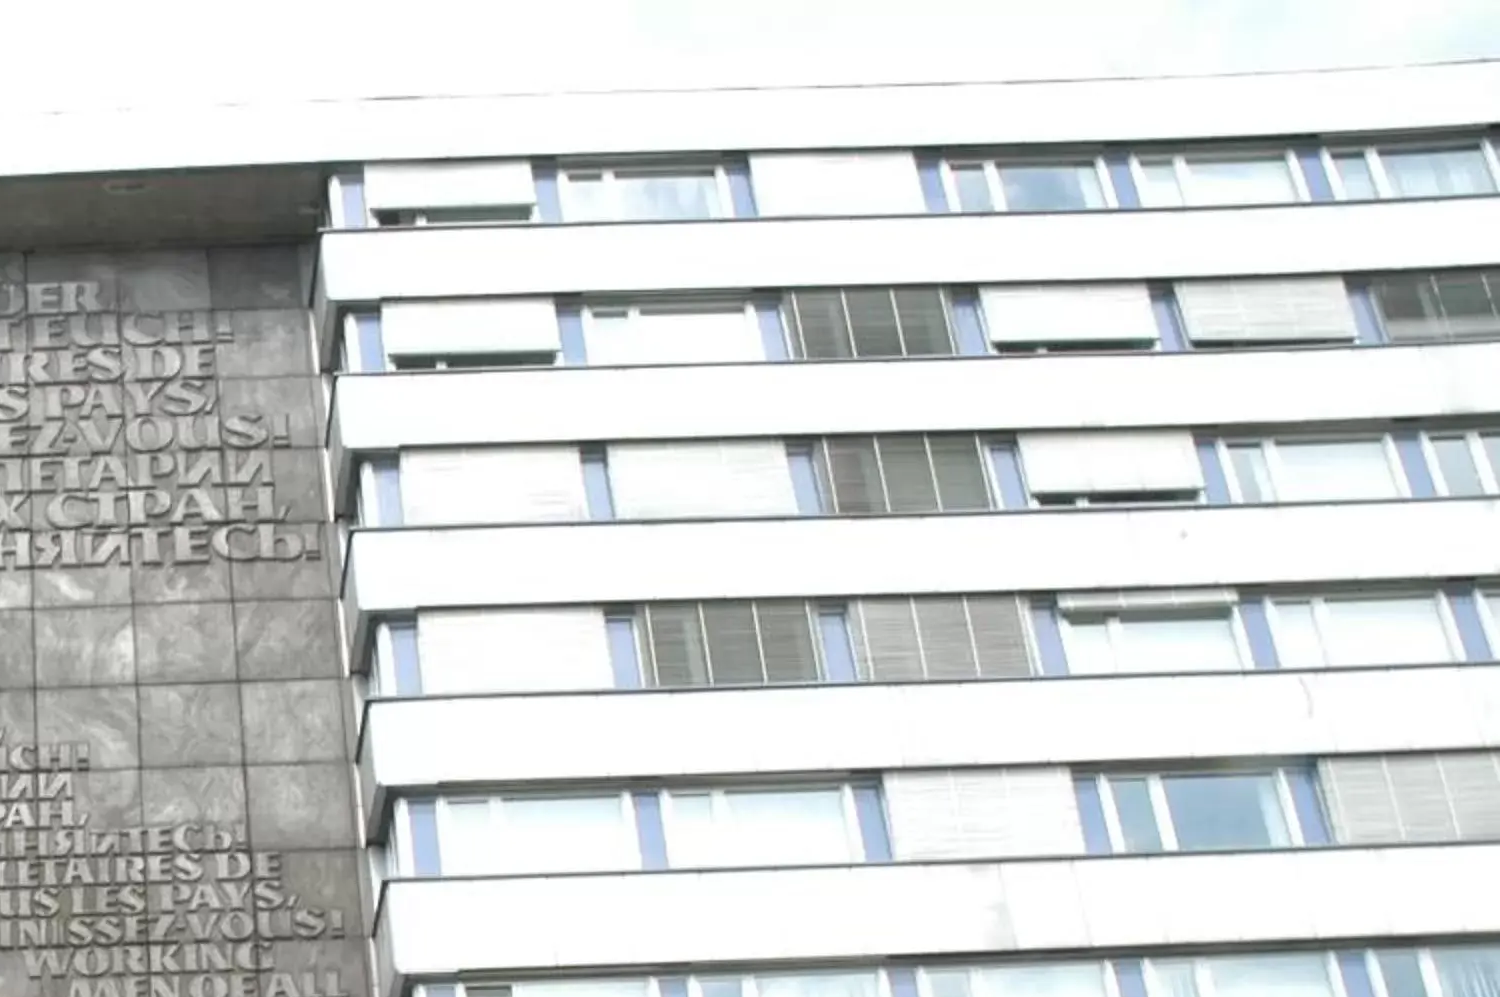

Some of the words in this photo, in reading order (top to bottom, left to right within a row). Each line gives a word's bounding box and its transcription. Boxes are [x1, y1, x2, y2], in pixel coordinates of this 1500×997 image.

[31, 308, 235, 351] EUCH!
[133, 342, 214, 382] DE
[45, 378, 218, 419] PAYS,
[46, 484, 292, 530] СТРАН,
[214, 851, 283, 882] DE
[70, 882, 148, 915] LES
[158, 879, 301, 912] PAYS,
[22, 942, 276, 980] WORKING
